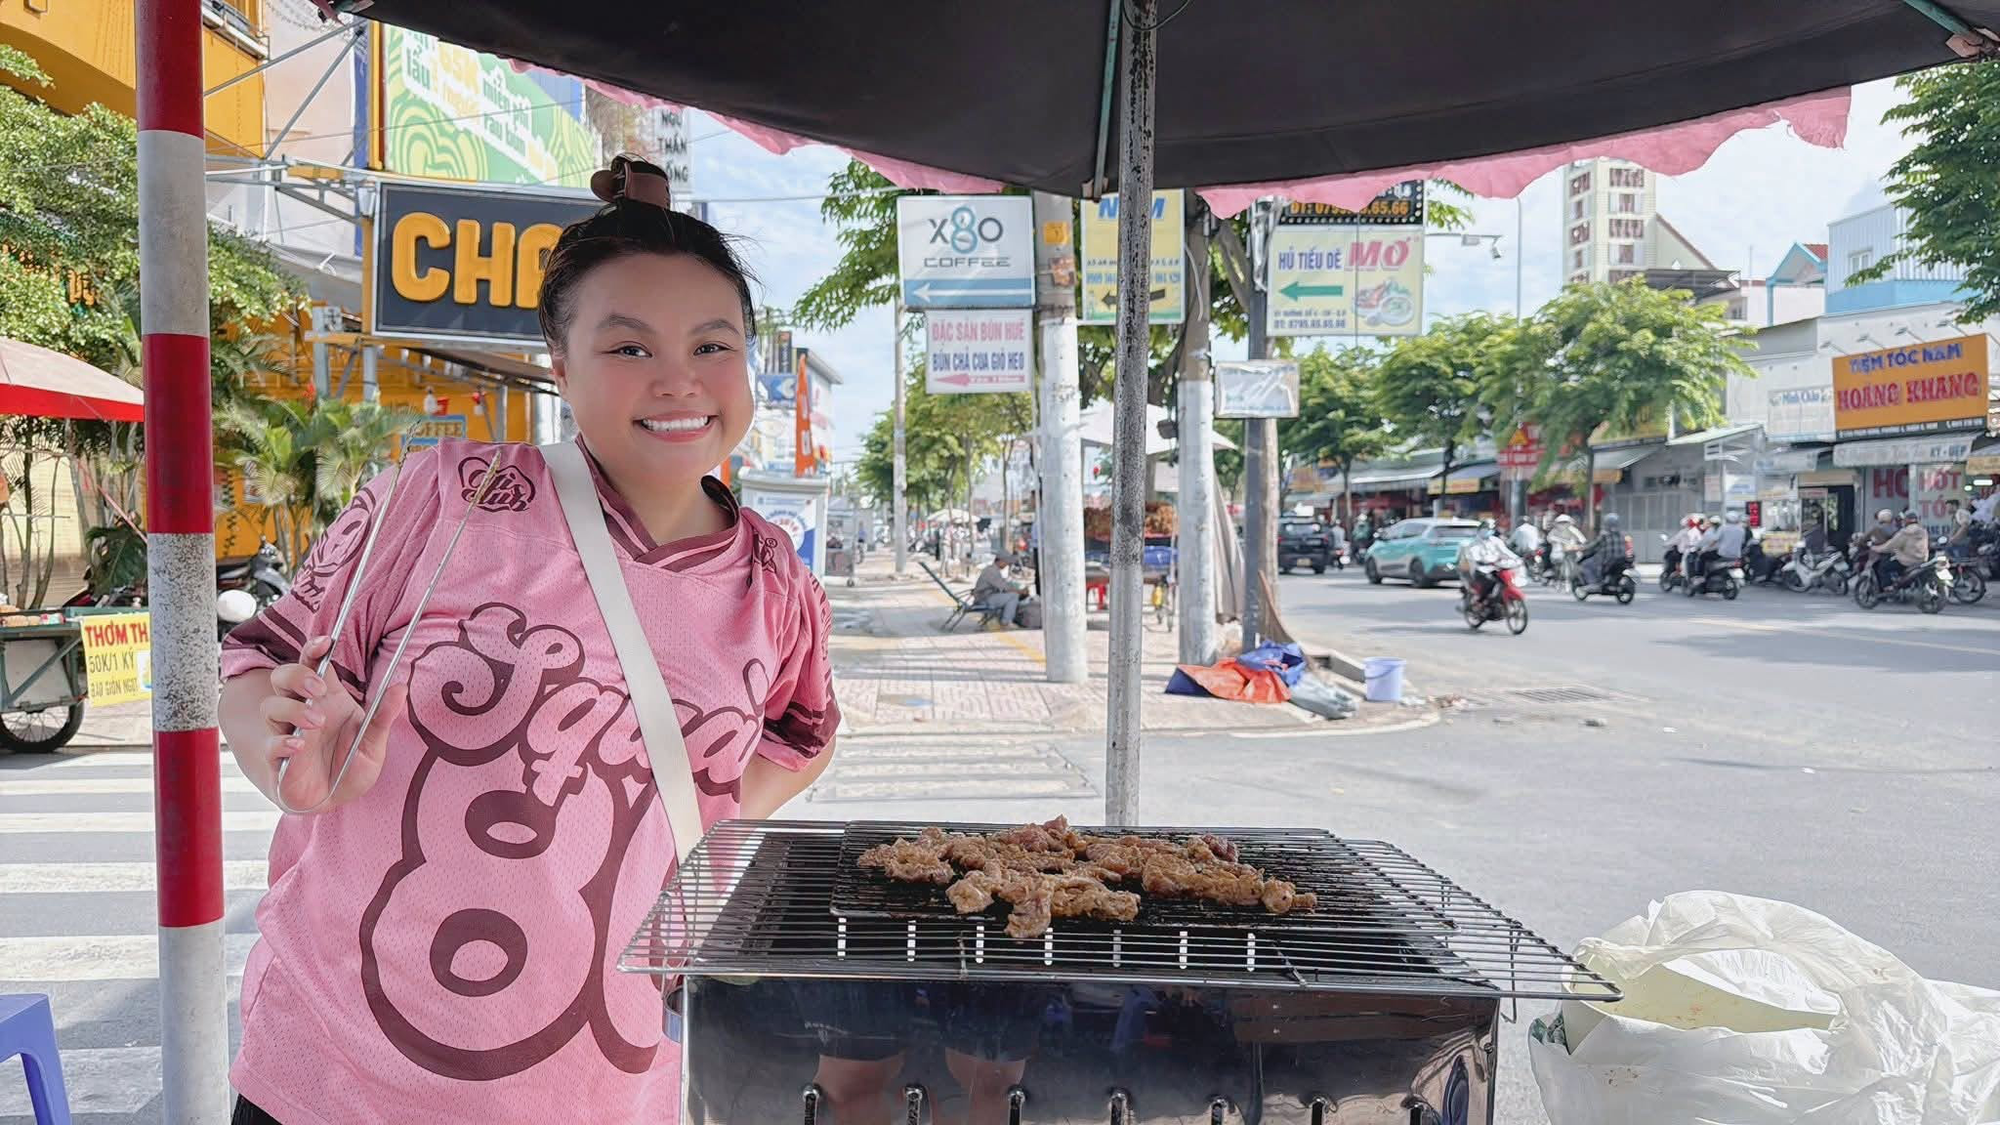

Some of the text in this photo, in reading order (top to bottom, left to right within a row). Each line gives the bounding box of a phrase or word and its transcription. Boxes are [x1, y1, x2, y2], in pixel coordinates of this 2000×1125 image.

[923, 256, 1012, 268] COFFEE
[1278, 245, 1295, 270] HỦ
[1297, 245, 1323, 270] TIẾU
[1349, 237, 1411, 268] MƠ
[1888, 346, 1919, 368] TÓC
[1923, 343, 1962, 363] NAM
[1906, 371, 1980, 404] KHANG
[85, 621, 149, 647] THƠM TH
